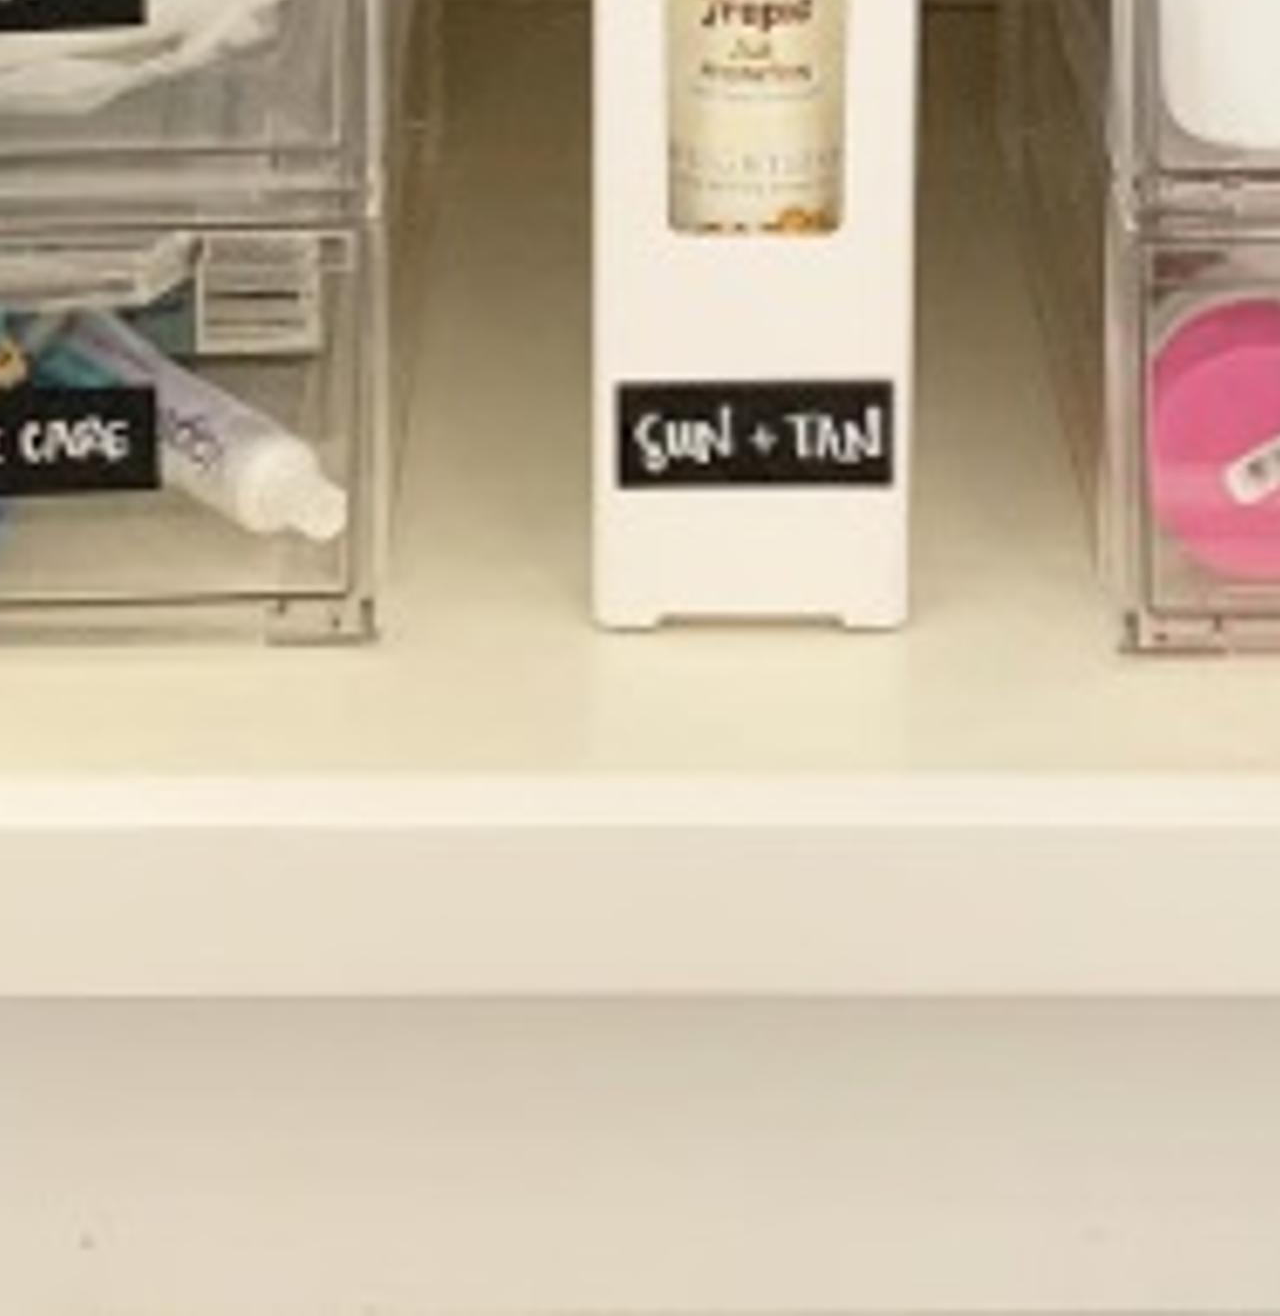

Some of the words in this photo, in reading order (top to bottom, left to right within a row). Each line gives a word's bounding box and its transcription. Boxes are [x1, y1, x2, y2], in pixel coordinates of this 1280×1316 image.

[19, 415, 127, 463] CARE
[632, 404, 733, 473] SUN
[783, 405, 882, 464] TAN
